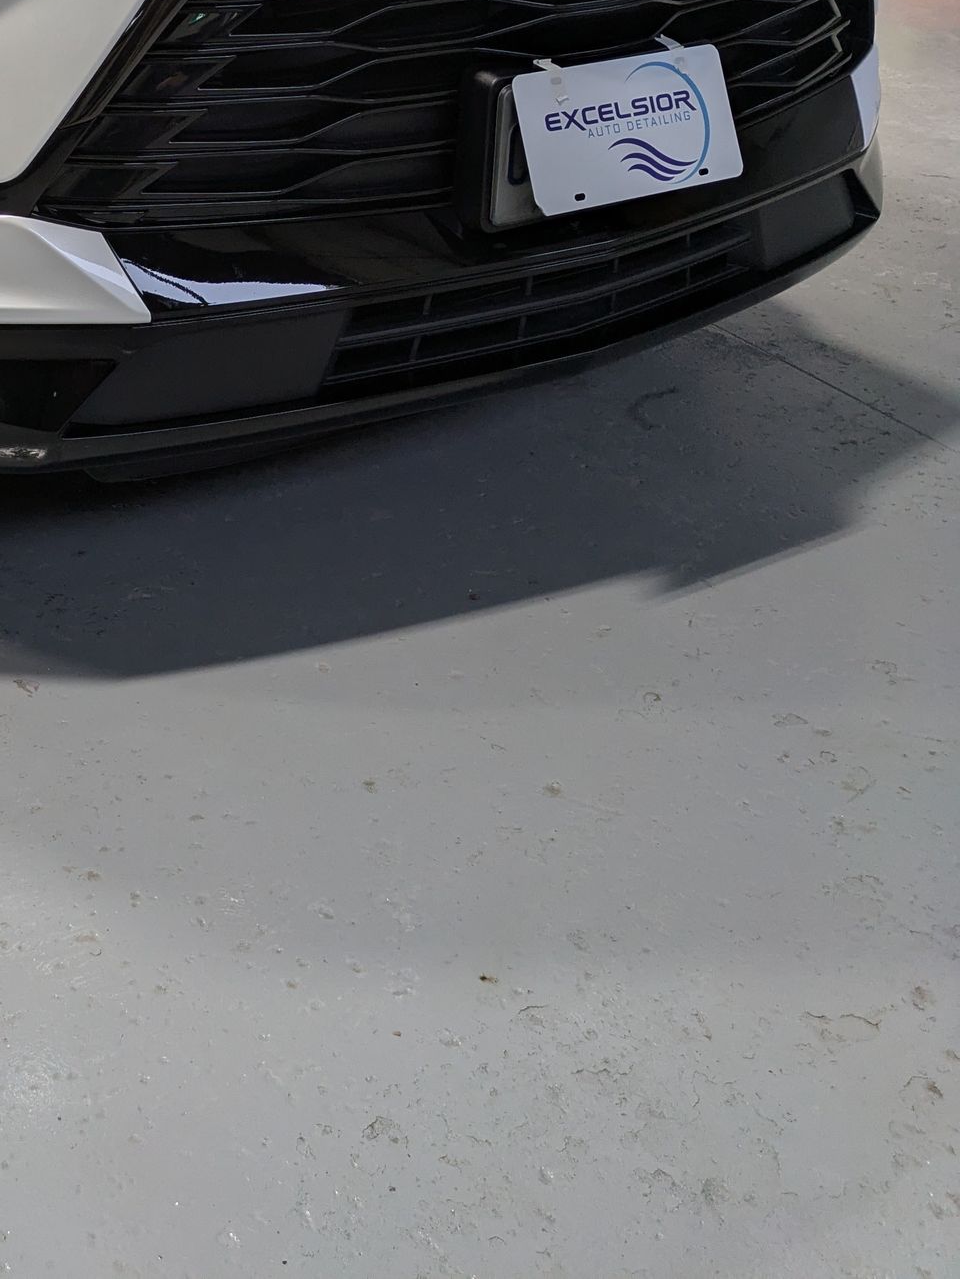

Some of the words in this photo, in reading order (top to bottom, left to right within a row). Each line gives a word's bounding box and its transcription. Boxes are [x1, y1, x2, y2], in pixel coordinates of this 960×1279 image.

[545, 90, 697, 132] EXCELSIOR
[588, 123, 620, 138] AUTO
[627, 110, 691, 131] DETAILING
